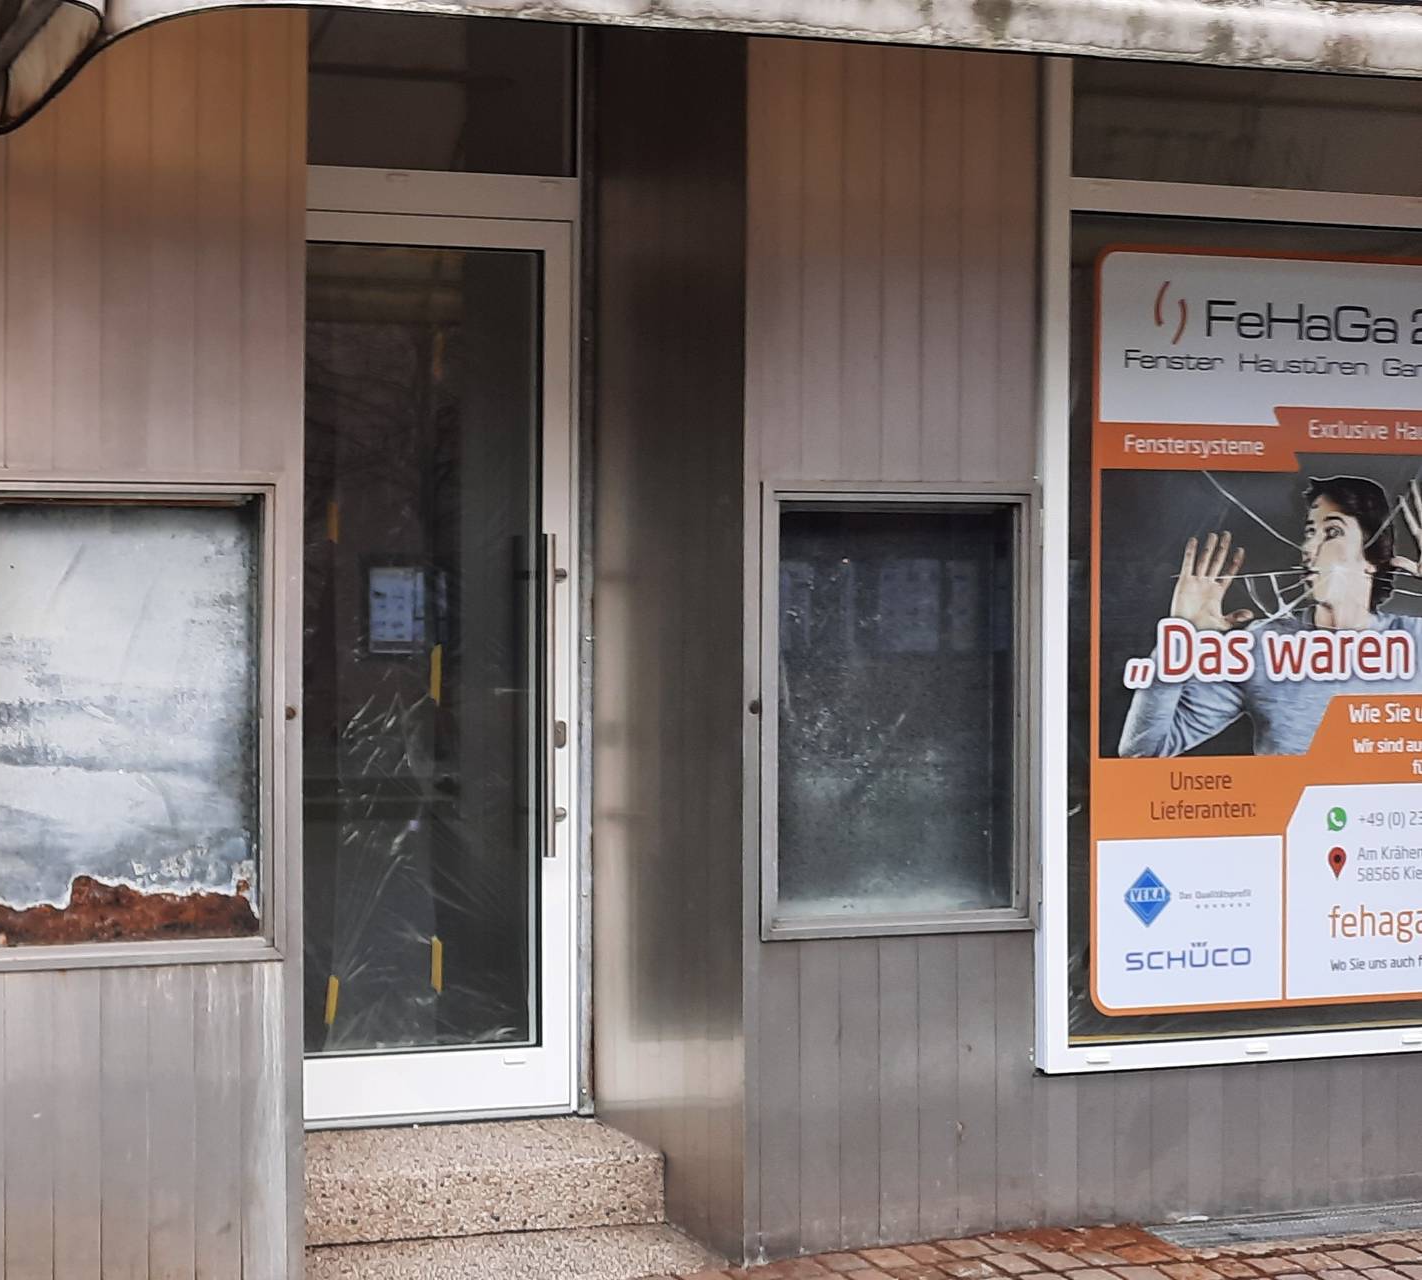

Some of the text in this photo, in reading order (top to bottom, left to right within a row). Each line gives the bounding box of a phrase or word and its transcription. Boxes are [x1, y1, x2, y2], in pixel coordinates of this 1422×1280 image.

[1206, 299, 1399, 344] FeHaGa
[1123, 349, 1223, 371] Fenster
[1239, 353, 1369, 376] Haustüren
[1308, 419, 1389, 440] Exclusive
[1123, 435, 1265, 459] Fenstersysteme
[1268, 635, 1410, 675] waren
[1348, 703, 1381, 723] Wie
[1384, 702, 1411, 723] Sie
[1353, 738, 1375, 753] Wir
[1377, 737, 1404, 753] sind
[1170, 771, 1232, 791] Unsere
[1150, 800, 1257, 822] Lieferanten:
[1358, 812, 1384, 827] +49
[1388, 811, 1406, 829] (0)
[1357, 847, 1378, 861] Am
[1358, 866, 1400, 882] 58566
[1132, 888, 1163, 901] VEKA
[1125, 941, 1251, 971] SCHÜCO
[1330, 959, 1347, 972] Wo
[1350, 958, 1366, 970] Sie
[1368, 959, 1387, 969] uns
[1390, 956, 1415, 969] auch
